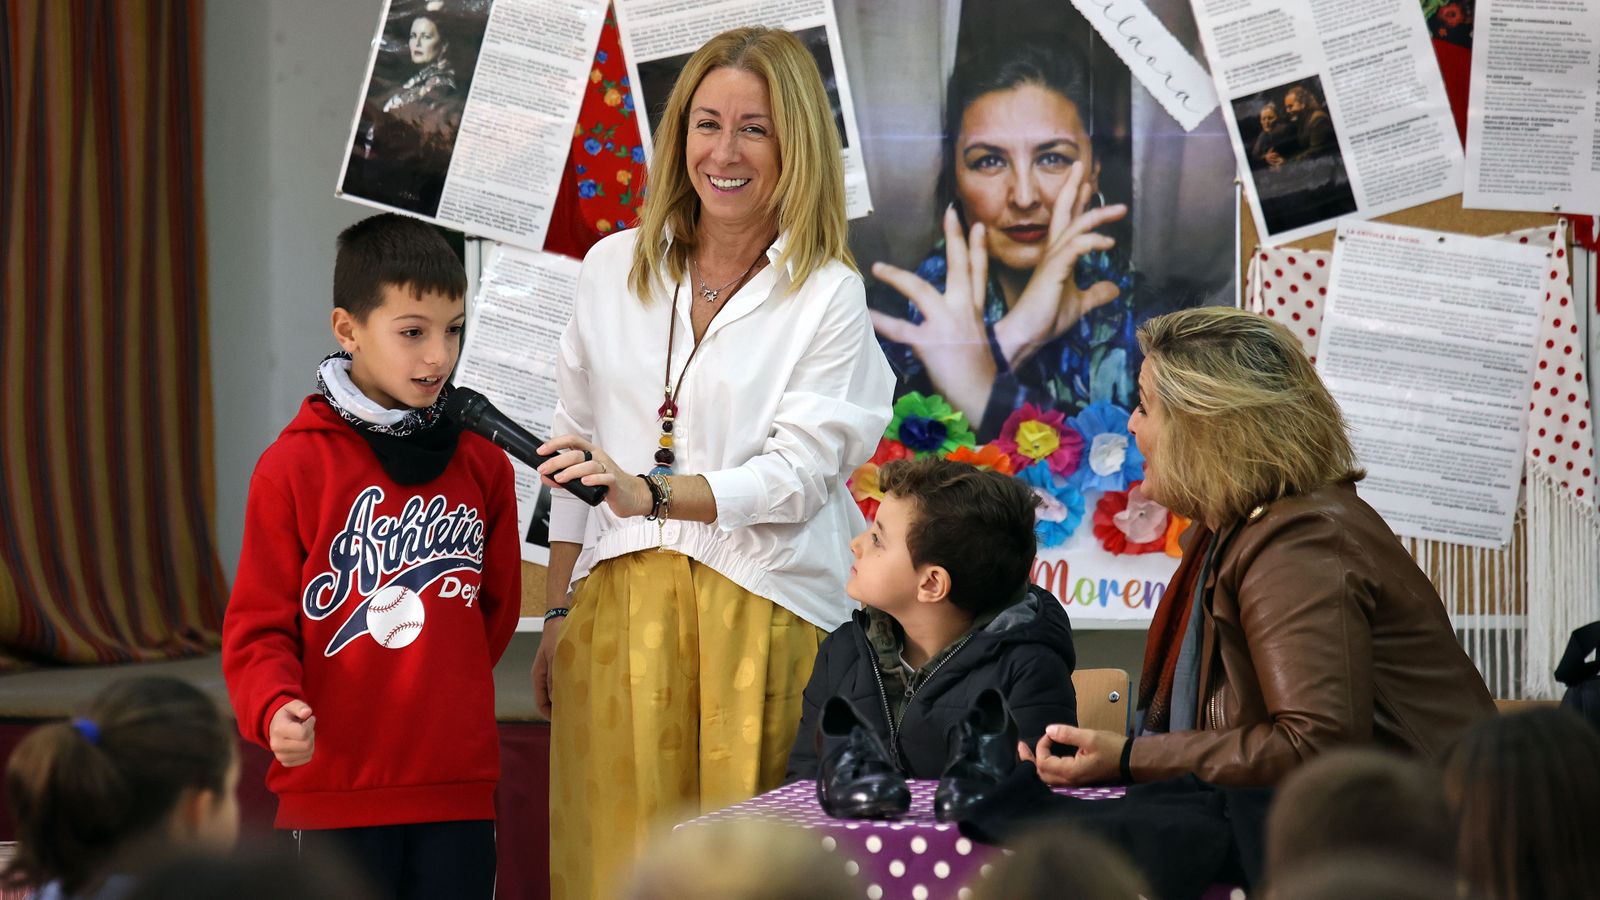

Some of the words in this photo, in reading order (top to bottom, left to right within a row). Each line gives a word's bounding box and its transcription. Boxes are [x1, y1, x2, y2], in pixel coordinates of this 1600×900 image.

[1090, 0, 1201, 114] ilaora
[438, 576, 482, 608] Dep
[1029, 557, 1165, 609] Moren
